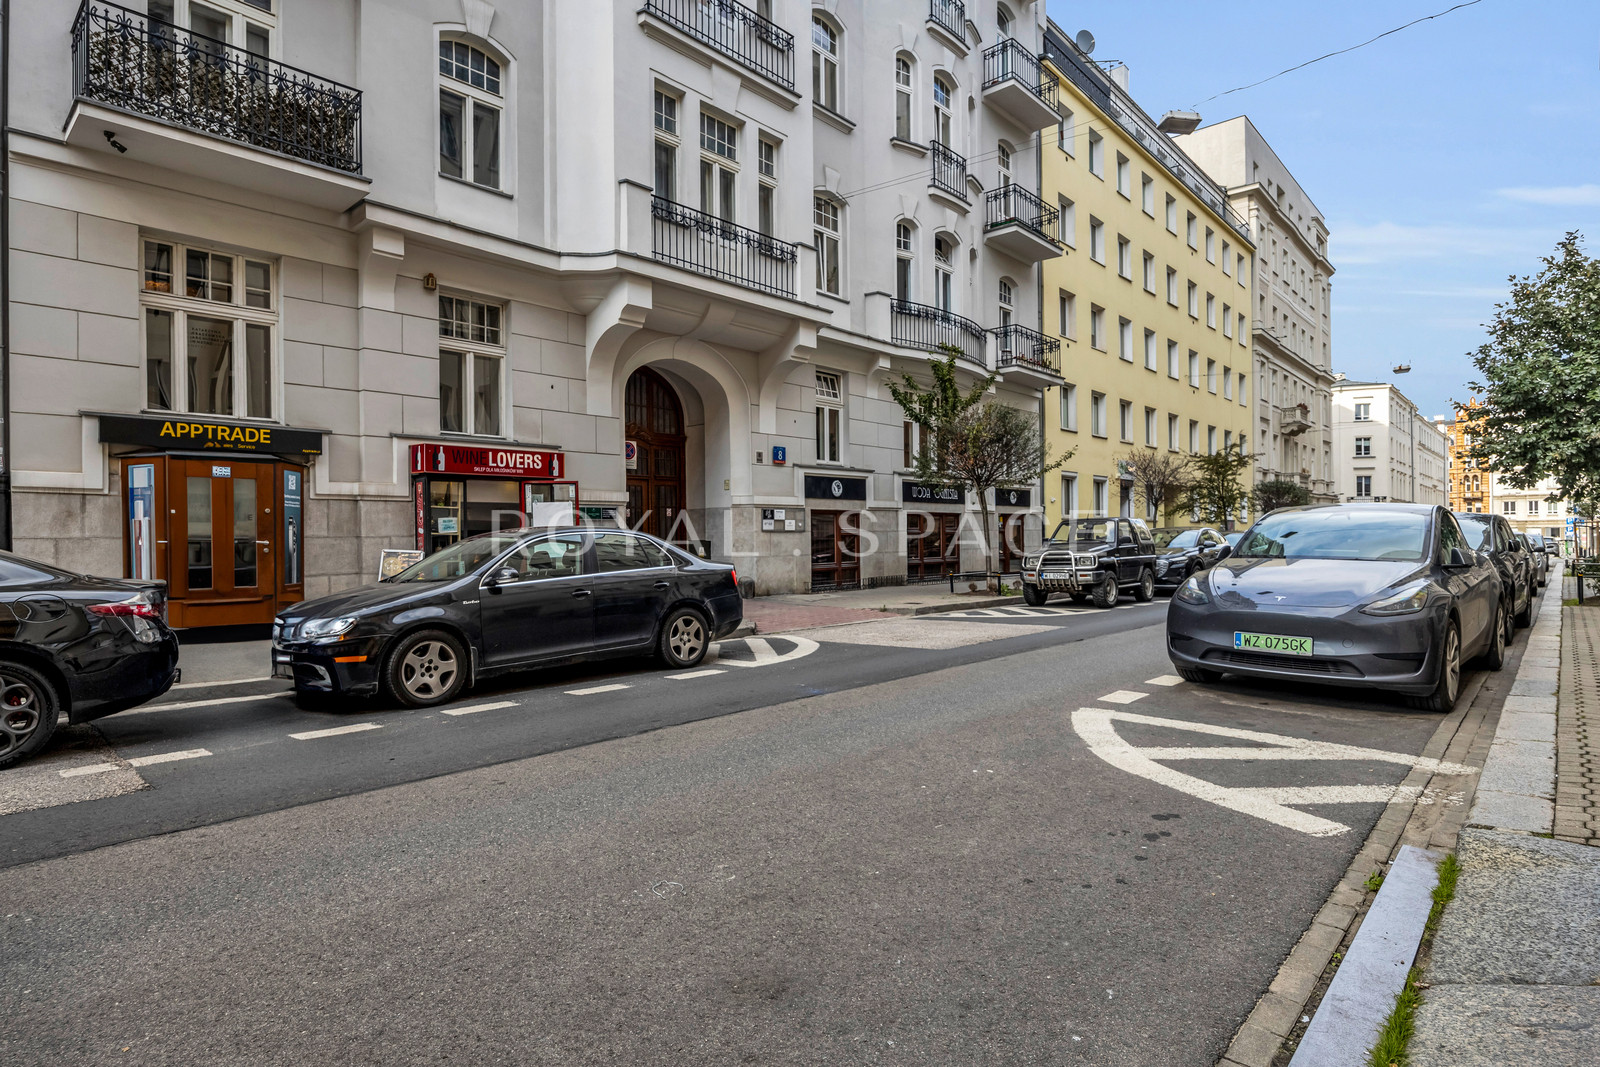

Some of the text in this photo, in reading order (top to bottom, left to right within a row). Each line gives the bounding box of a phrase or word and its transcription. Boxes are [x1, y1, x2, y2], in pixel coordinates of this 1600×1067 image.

[160, 422, 271, 443] APPTRADE
[778, 450, 783, 460] 8
[911, 486, 931, 499] WODA
[1244, 635, 1307, 652] WZ 075GK
